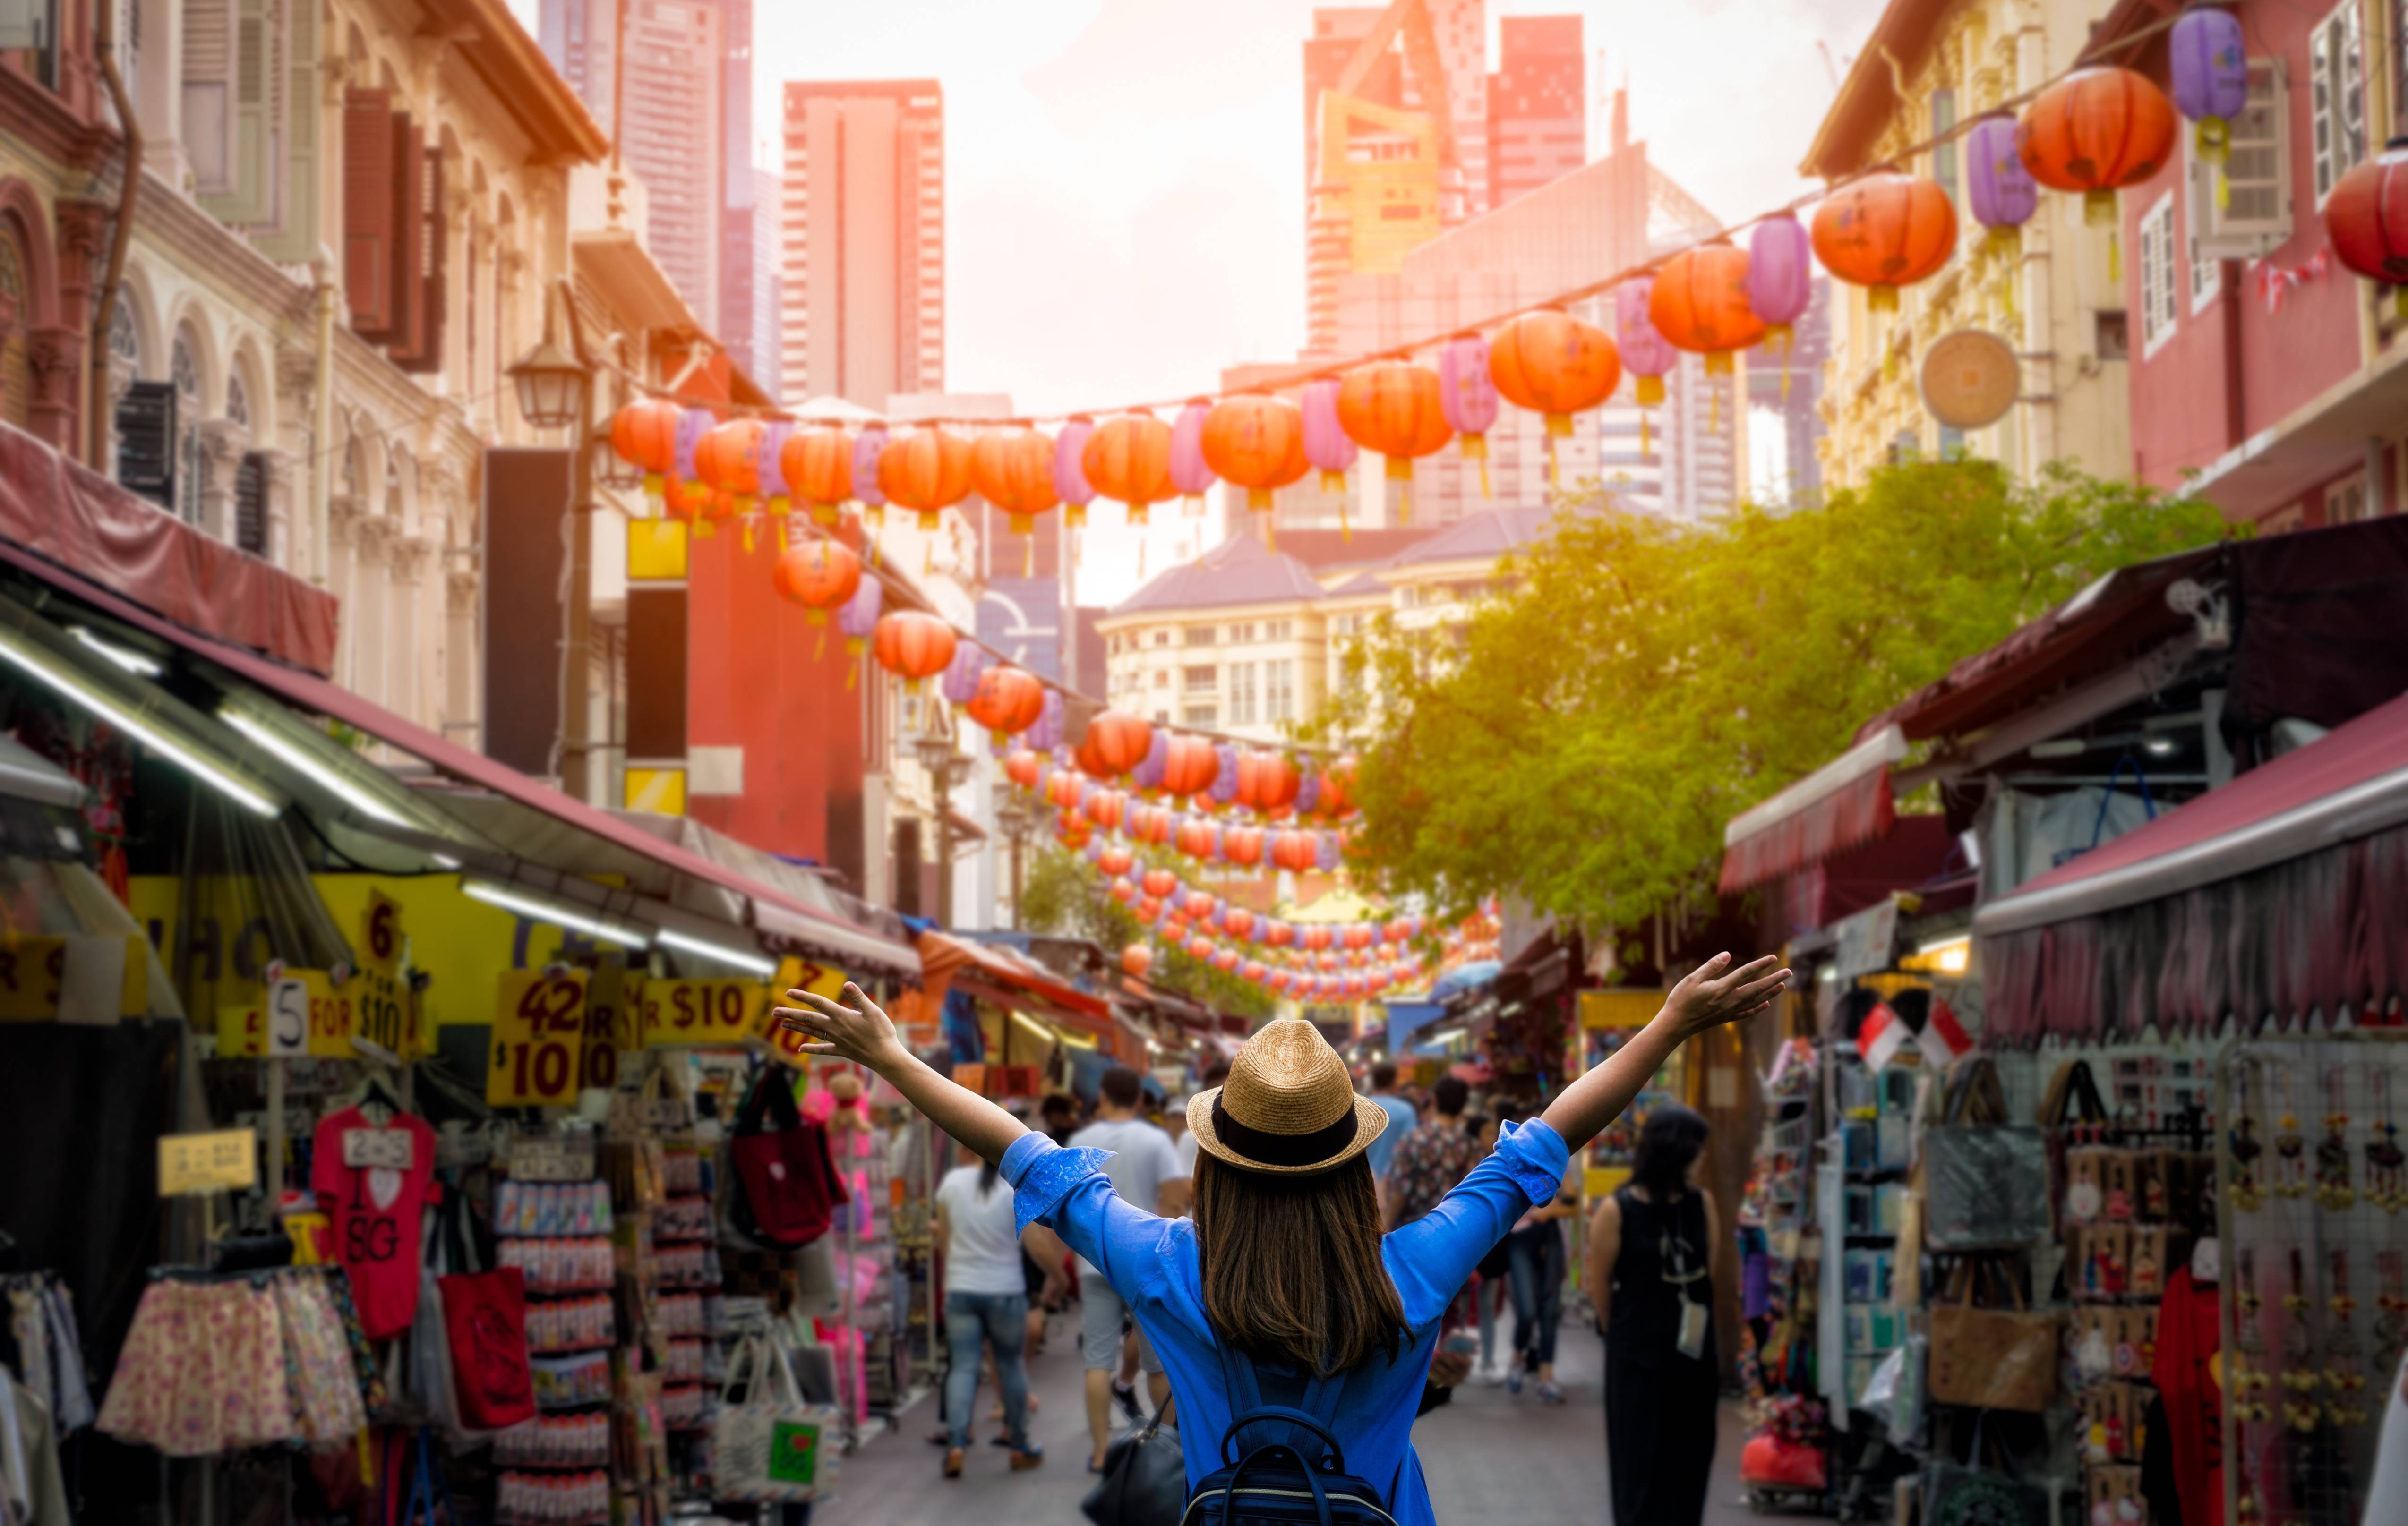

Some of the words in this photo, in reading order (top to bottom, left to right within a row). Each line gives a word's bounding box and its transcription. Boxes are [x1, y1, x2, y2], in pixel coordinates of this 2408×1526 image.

[372, 904, 392, 957] 6
[277, 983, 302, 1047] 5
[309, 997, 351, 1037] FOR
[519, 980, 582, 1033] 42
[671, 984, 743, 1029] $10
[514, 1042, 568, 1096] 10
[347, 1216, 401, 1264] SG
